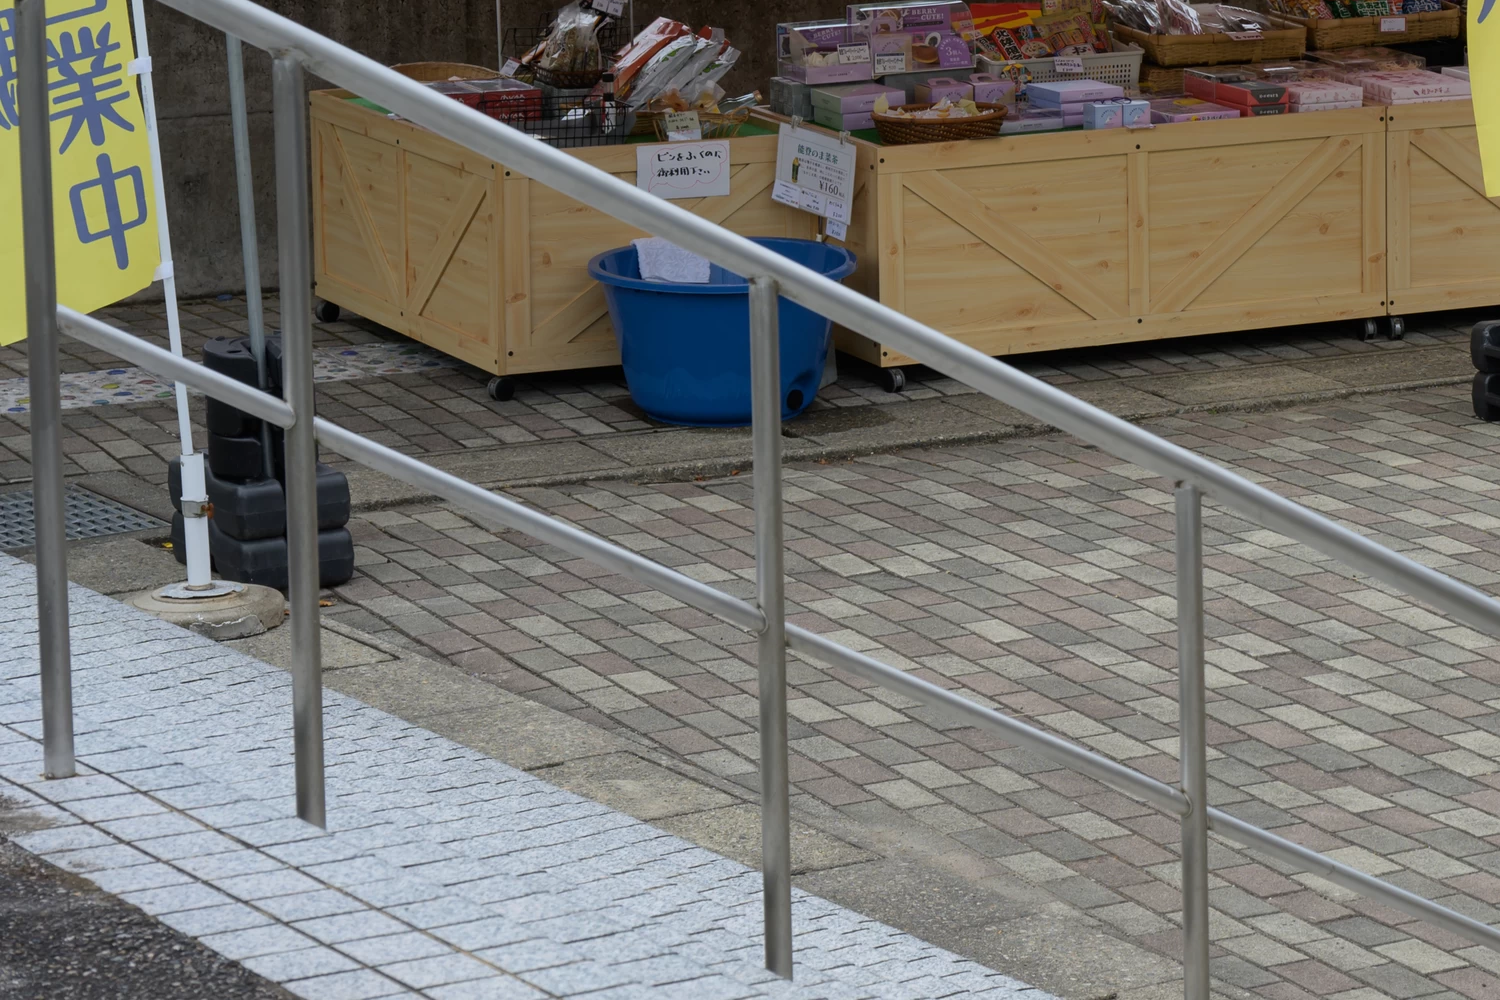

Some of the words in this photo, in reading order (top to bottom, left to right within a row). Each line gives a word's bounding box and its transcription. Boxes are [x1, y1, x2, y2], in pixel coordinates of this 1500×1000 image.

[911, 7, 937, 16] BERRY
[920, 13, 944, 21] CUTE!
[813, 28, 834, 39] BERRY
[822, 30, 842, 41] CUTE!
[945, 46, 963, 56] 3個入
[818, 179, 839, 196] ¥160
